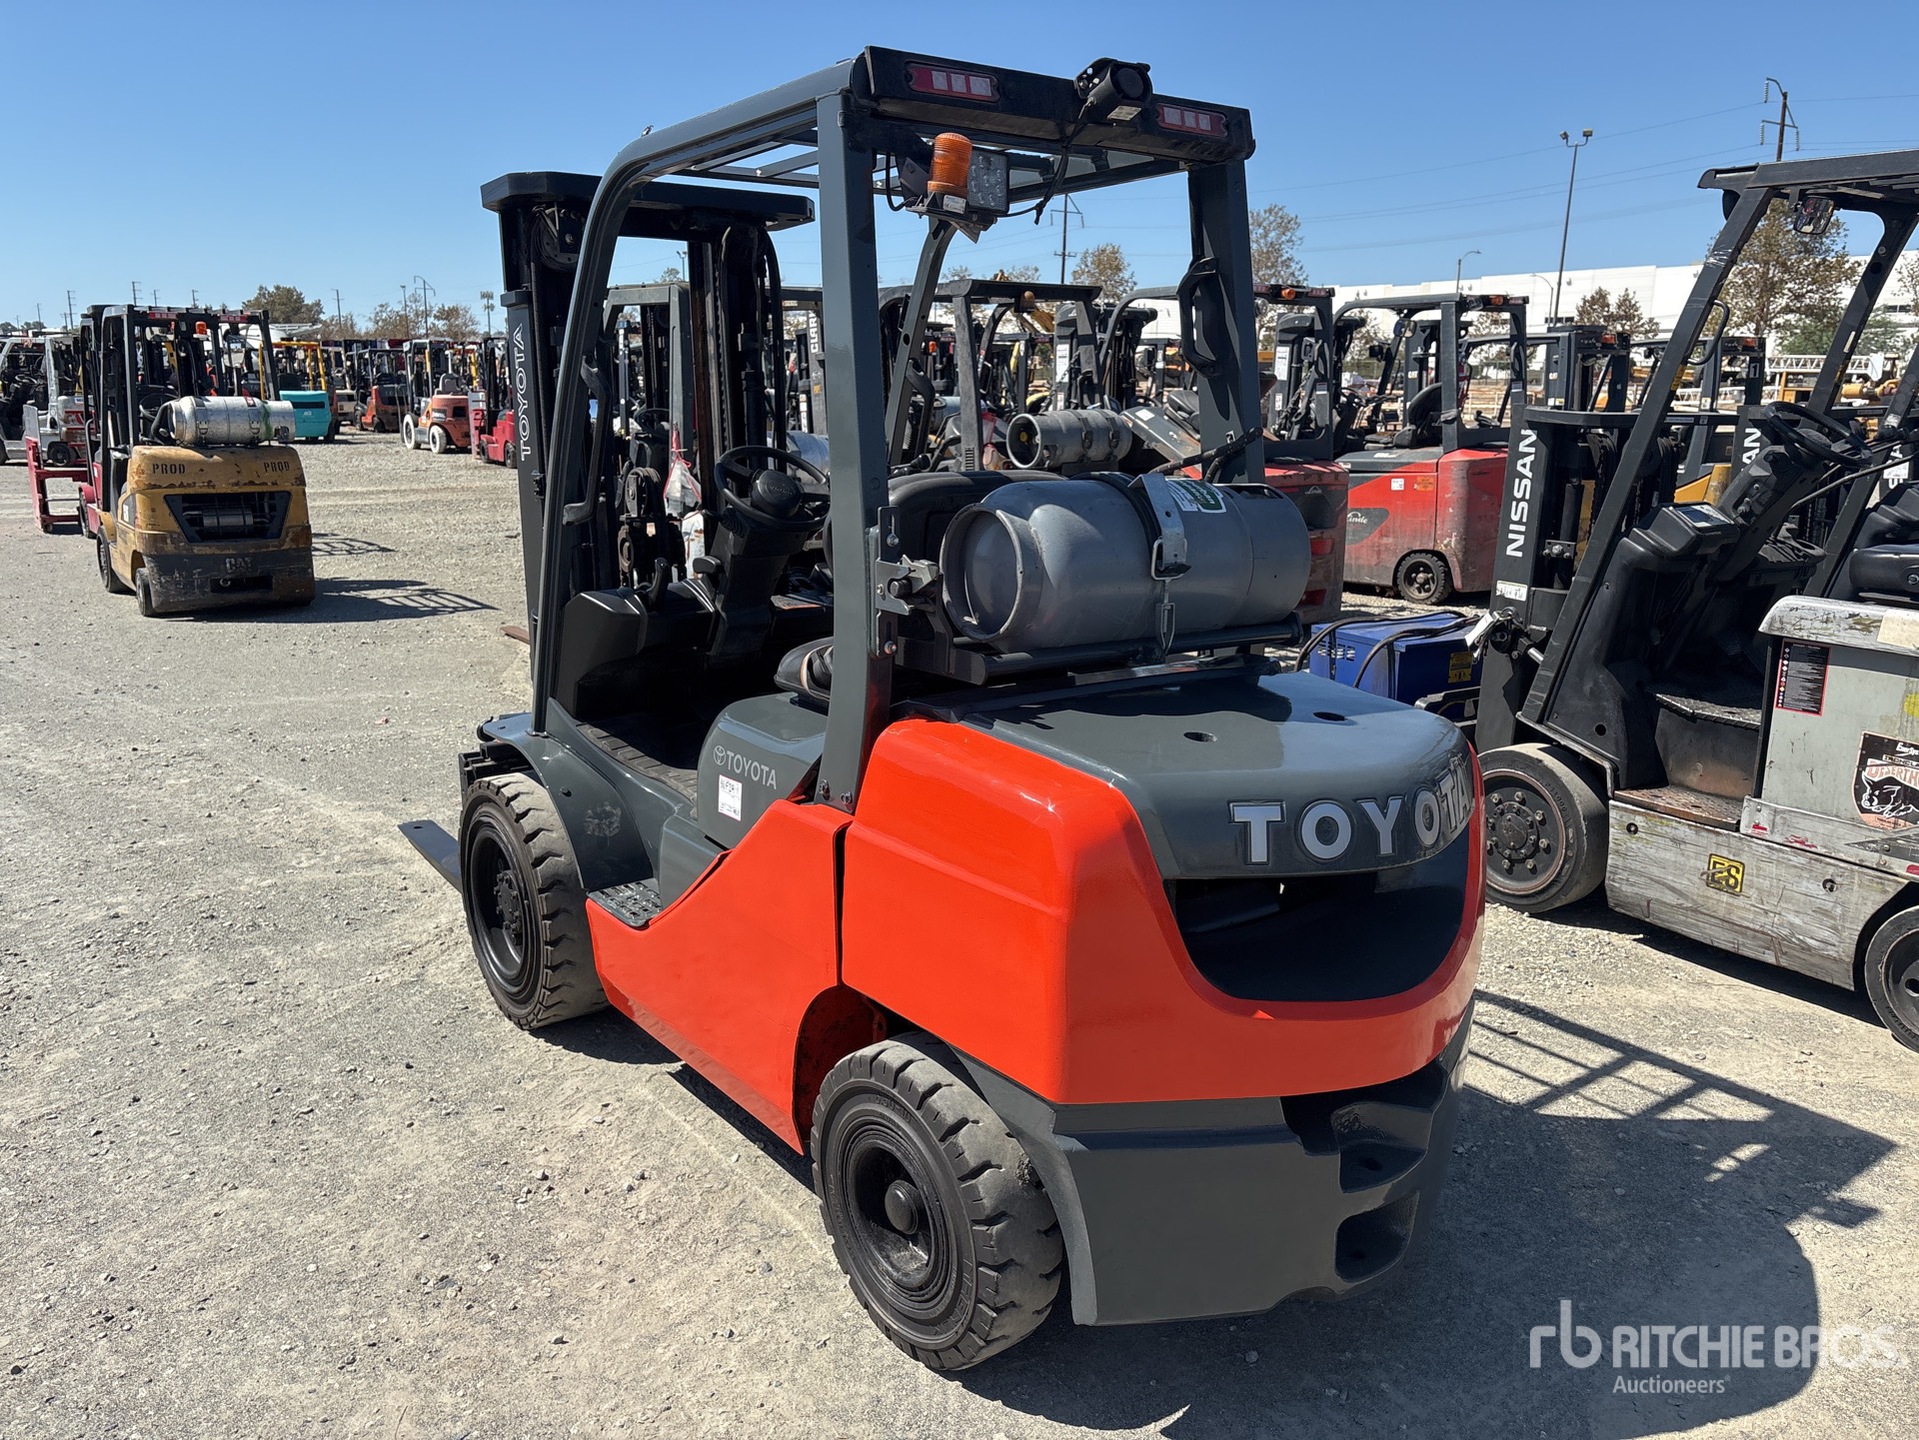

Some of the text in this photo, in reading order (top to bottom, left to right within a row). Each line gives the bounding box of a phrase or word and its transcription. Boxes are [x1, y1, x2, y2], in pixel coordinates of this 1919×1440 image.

[808, 310, 818, 353] CLARK
[513, 323, 531, 462] TOYOTA
[153, 463, 186, 475] PROD
[263, 461, 290, 473] PROD
[1506, 429, 1537, 558] NISSAN
[727, 750, 777, 790] TOYOTA
[1867, 760, 1919, 790] DESERTH
[1229, 757, 1474, 865] TOYOTA
